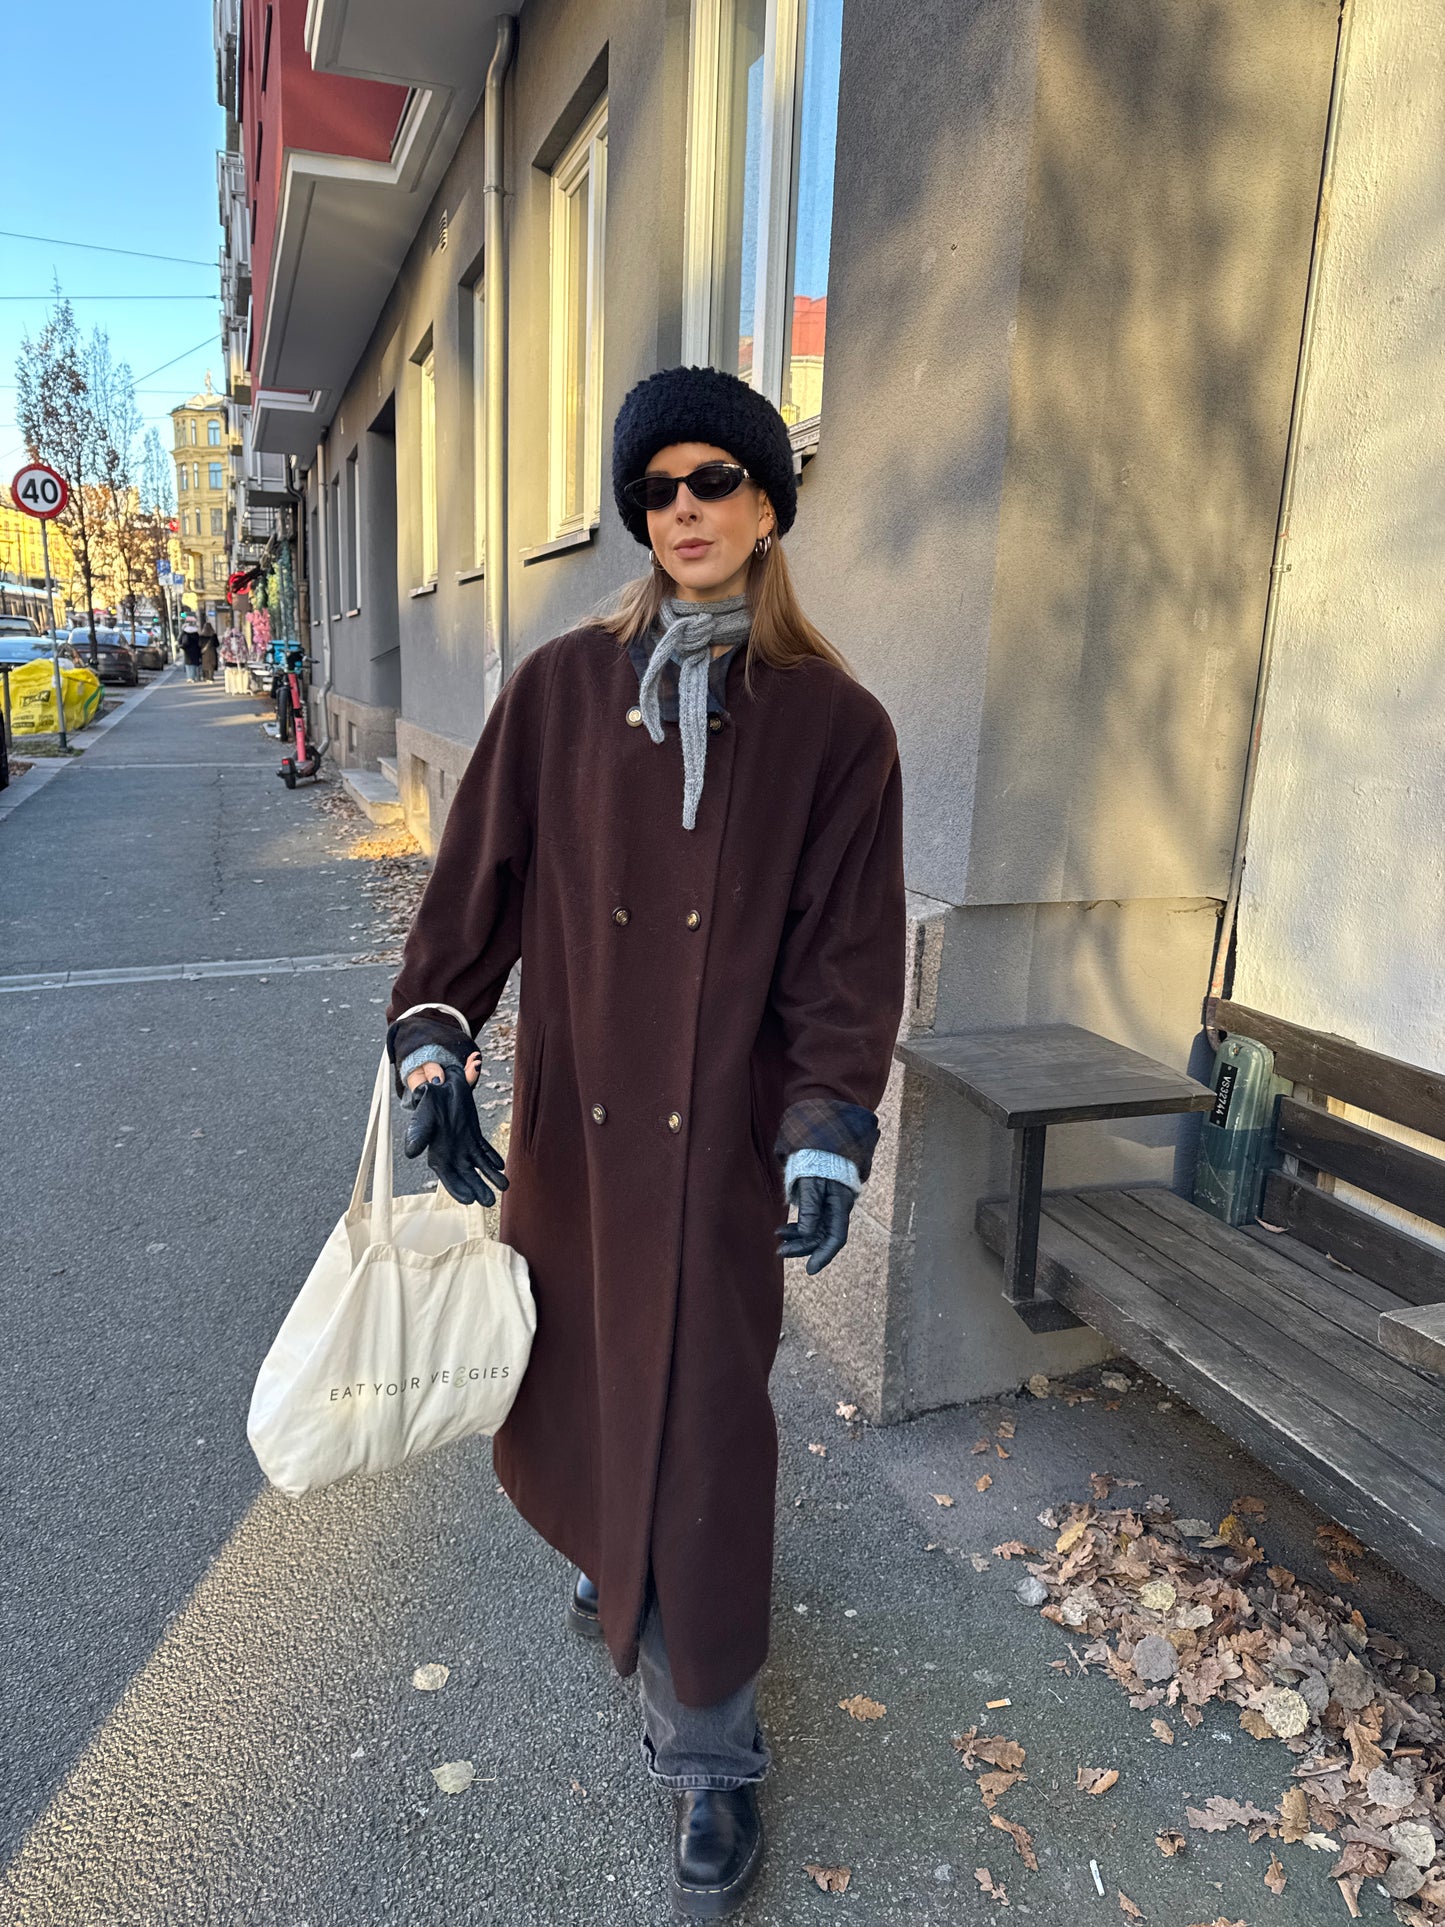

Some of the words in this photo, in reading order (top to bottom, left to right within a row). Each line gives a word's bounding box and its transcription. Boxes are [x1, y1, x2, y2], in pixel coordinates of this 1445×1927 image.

[21, 478, 59, 504] 40
[1216, 1076, 1232, 1115] VS32744
[329, 1383, 366, 1401] EAT
[373, 1376, 421, 1396] YOUR
